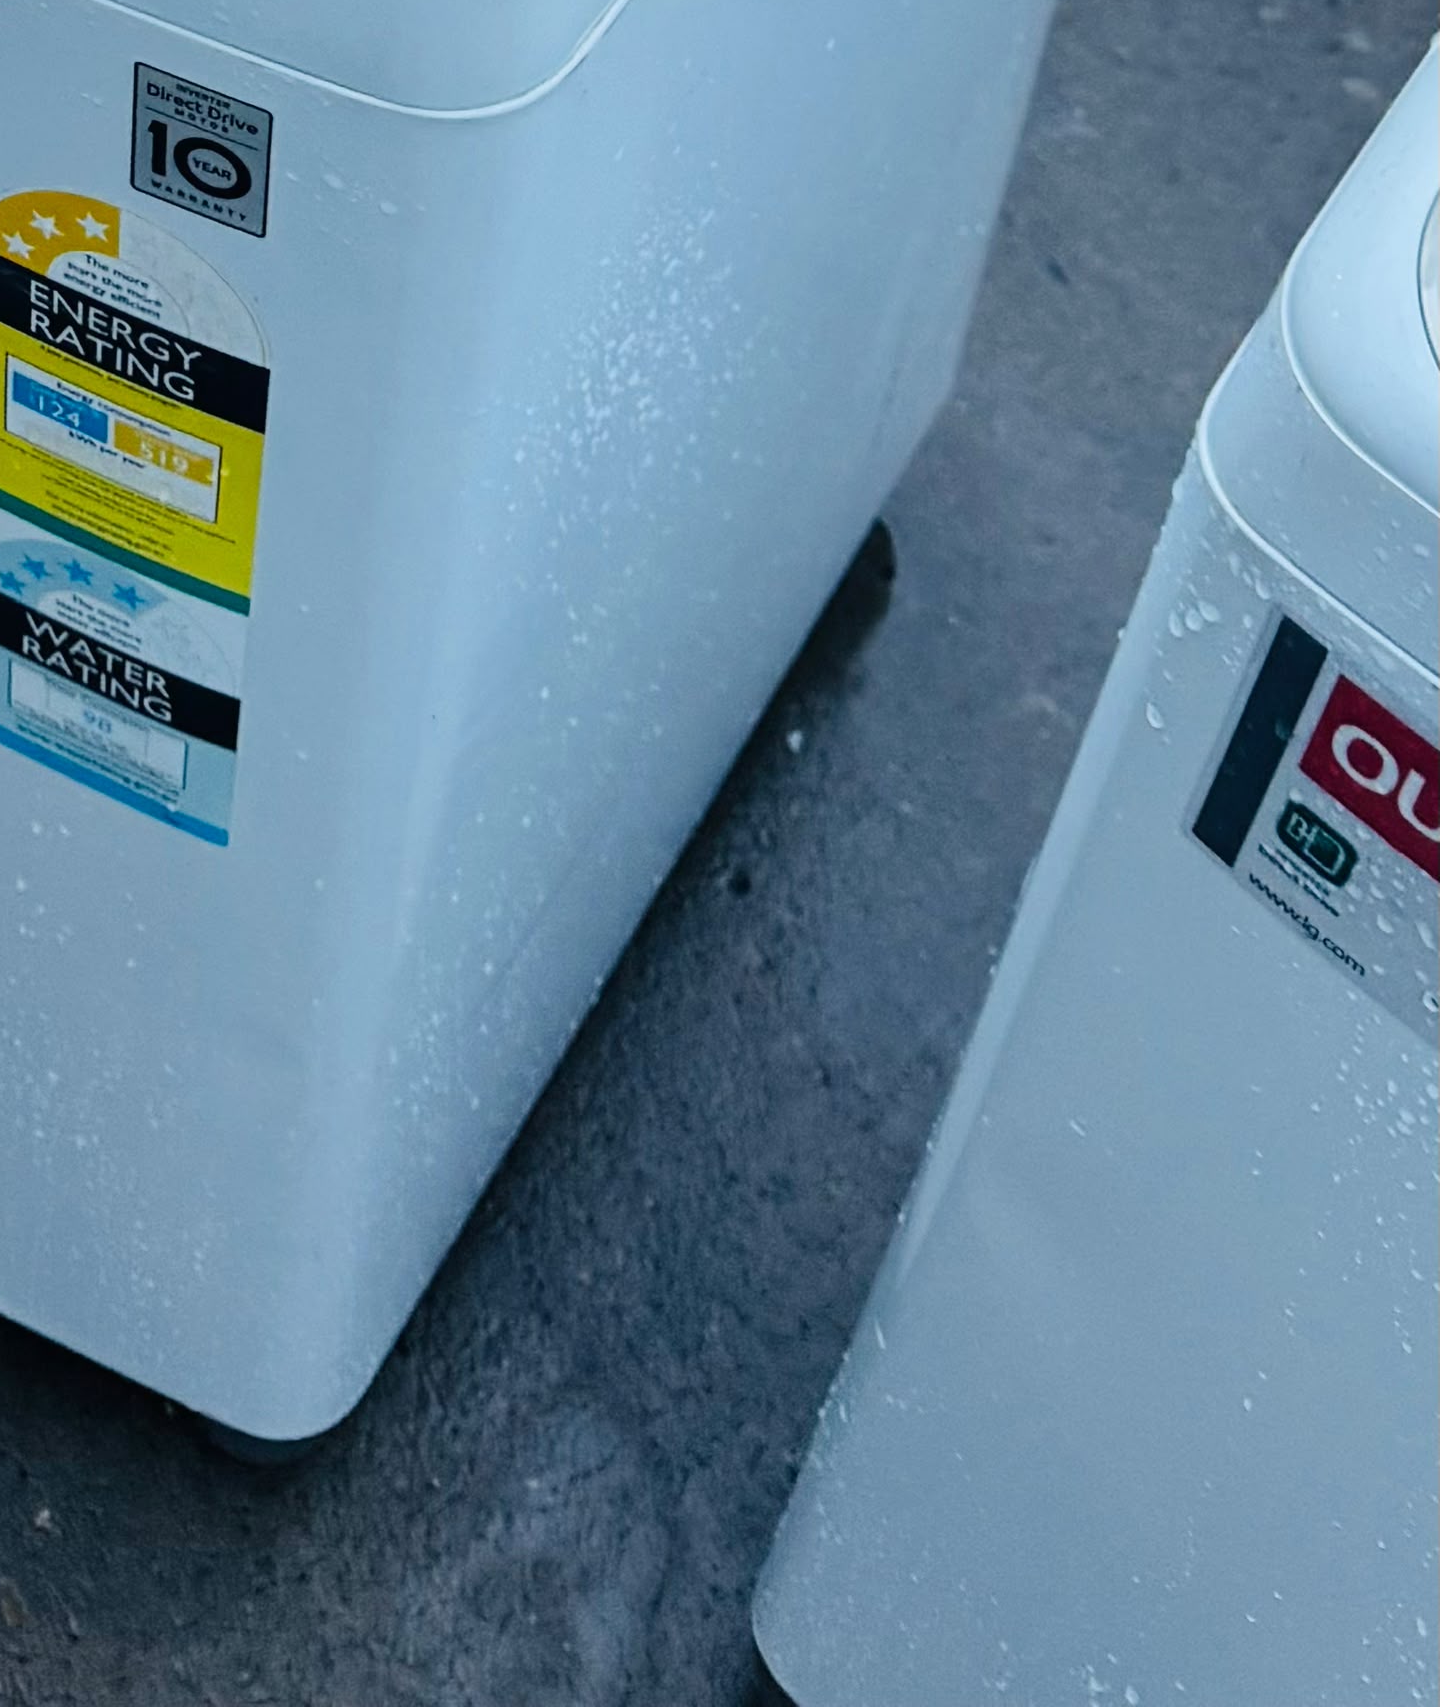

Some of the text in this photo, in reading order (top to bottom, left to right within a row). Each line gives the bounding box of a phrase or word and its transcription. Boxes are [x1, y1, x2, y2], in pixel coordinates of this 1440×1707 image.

[146, 82, 259, 136] Direct Drive
[148, 119, 252, 200] 10
[193, 156, 232, 182] YEAR
[151, 179, 247, 222] WARRANTY
[63, 272, 160, 319] energy efficient
[85, 254, 149, 289] The more
[102, 277, 123, 291] the
[127, 289, 163, 308] more
[30, 279, 202, 371] ENERGY
[30, 309, 195, 401] RATING
[38, 395, 80, 427] 124
[23, 634, 172, 722] RATING
[26, 611, 170, 698] WATER
